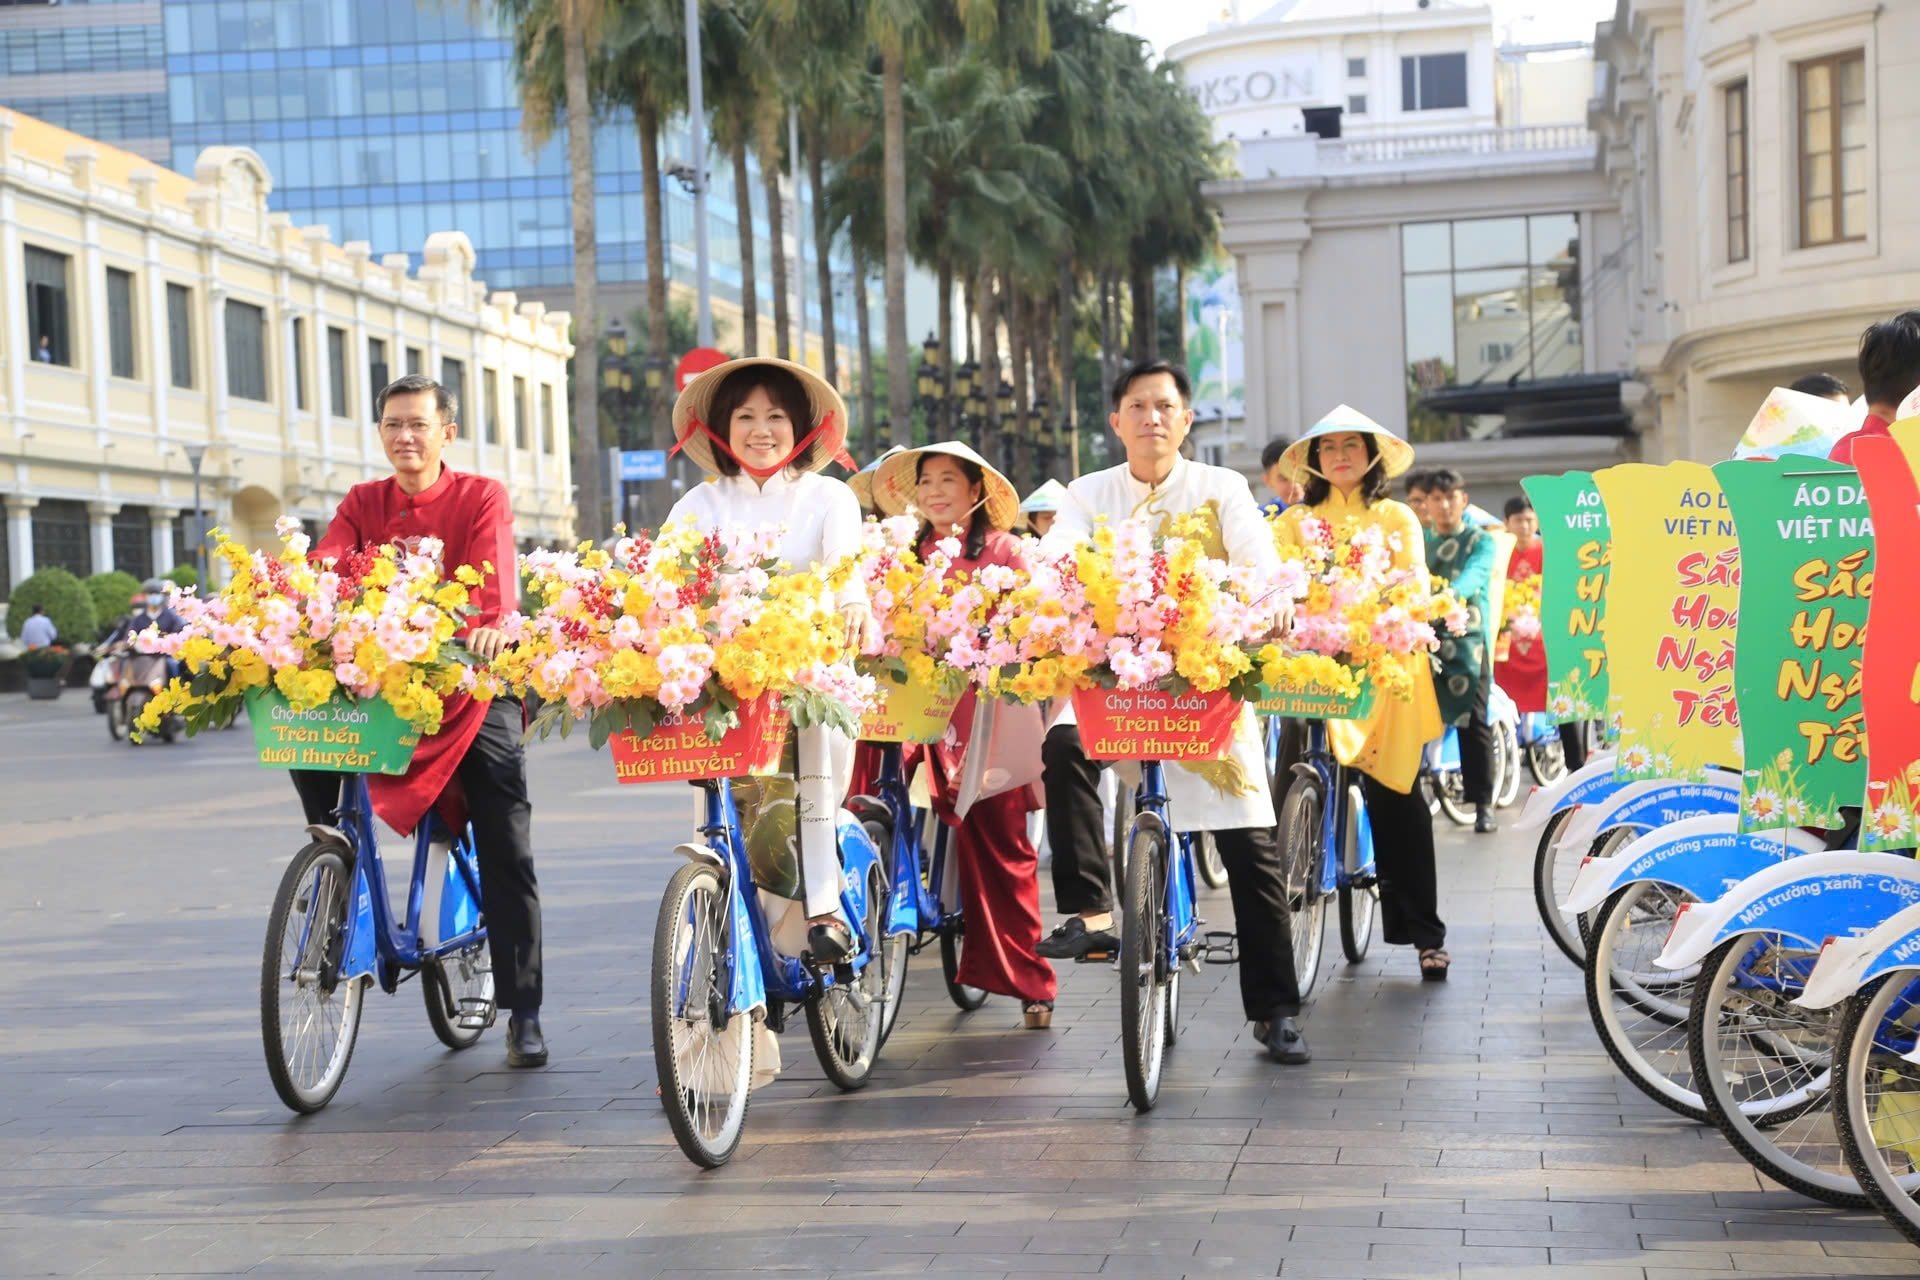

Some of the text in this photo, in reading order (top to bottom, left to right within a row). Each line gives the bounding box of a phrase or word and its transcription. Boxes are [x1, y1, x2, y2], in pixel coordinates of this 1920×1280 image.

[1576, 490, 1600, 507] ÁO
[1680, 488, 1711, 508] ÁO
[1793, 482, 1831, 506] ÁO
[1565, 511, 1602, 532] VIỆT
[1664, 515, 1736, 540] VIỆT N
[1776, 514, 1832, 544] VIỆT
[1105, 694, 1208, 712] Chợ Hoa Xuân
[1672, 684, 1740, 728] Tết
[1164, 714, 1201, 732] bến
[323, 726, 361, 745] bến
[261, 747, 297, 763] dưới
[1095, 738, 1138, 755] dưới
[1631, 855, 1655, 877] Môi
[1655, 840, 1701, 863] trường
[1703, 836, 1737, 847] xanh
[1739, 901, 1768, 925] Môi
[1767, 881, 1821, 908] trường
[1823, 876, 1862, 891] xanh
